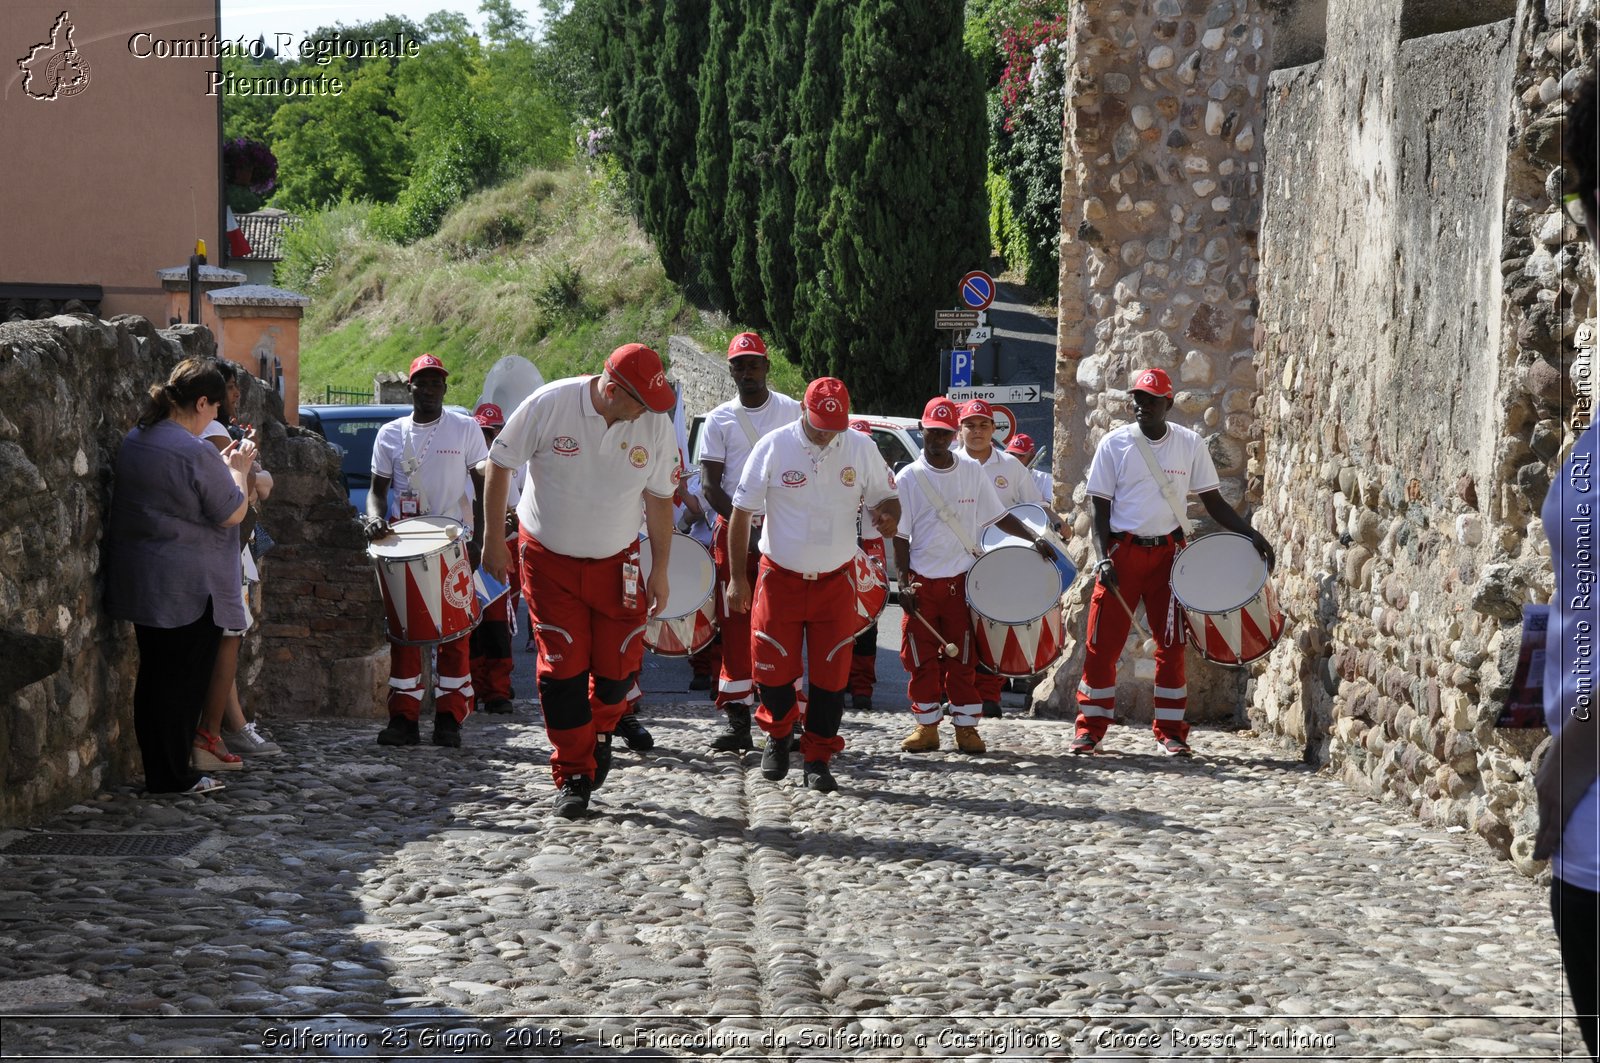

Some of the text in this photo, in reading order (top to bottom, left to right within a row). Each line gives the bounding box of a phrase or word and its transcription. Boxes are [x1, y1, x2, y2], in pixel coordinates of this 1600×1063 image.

[975, 331, 987, 339] 24
[956, 354, 968, 375] P
[951, 391, 995, 400] cimitero
